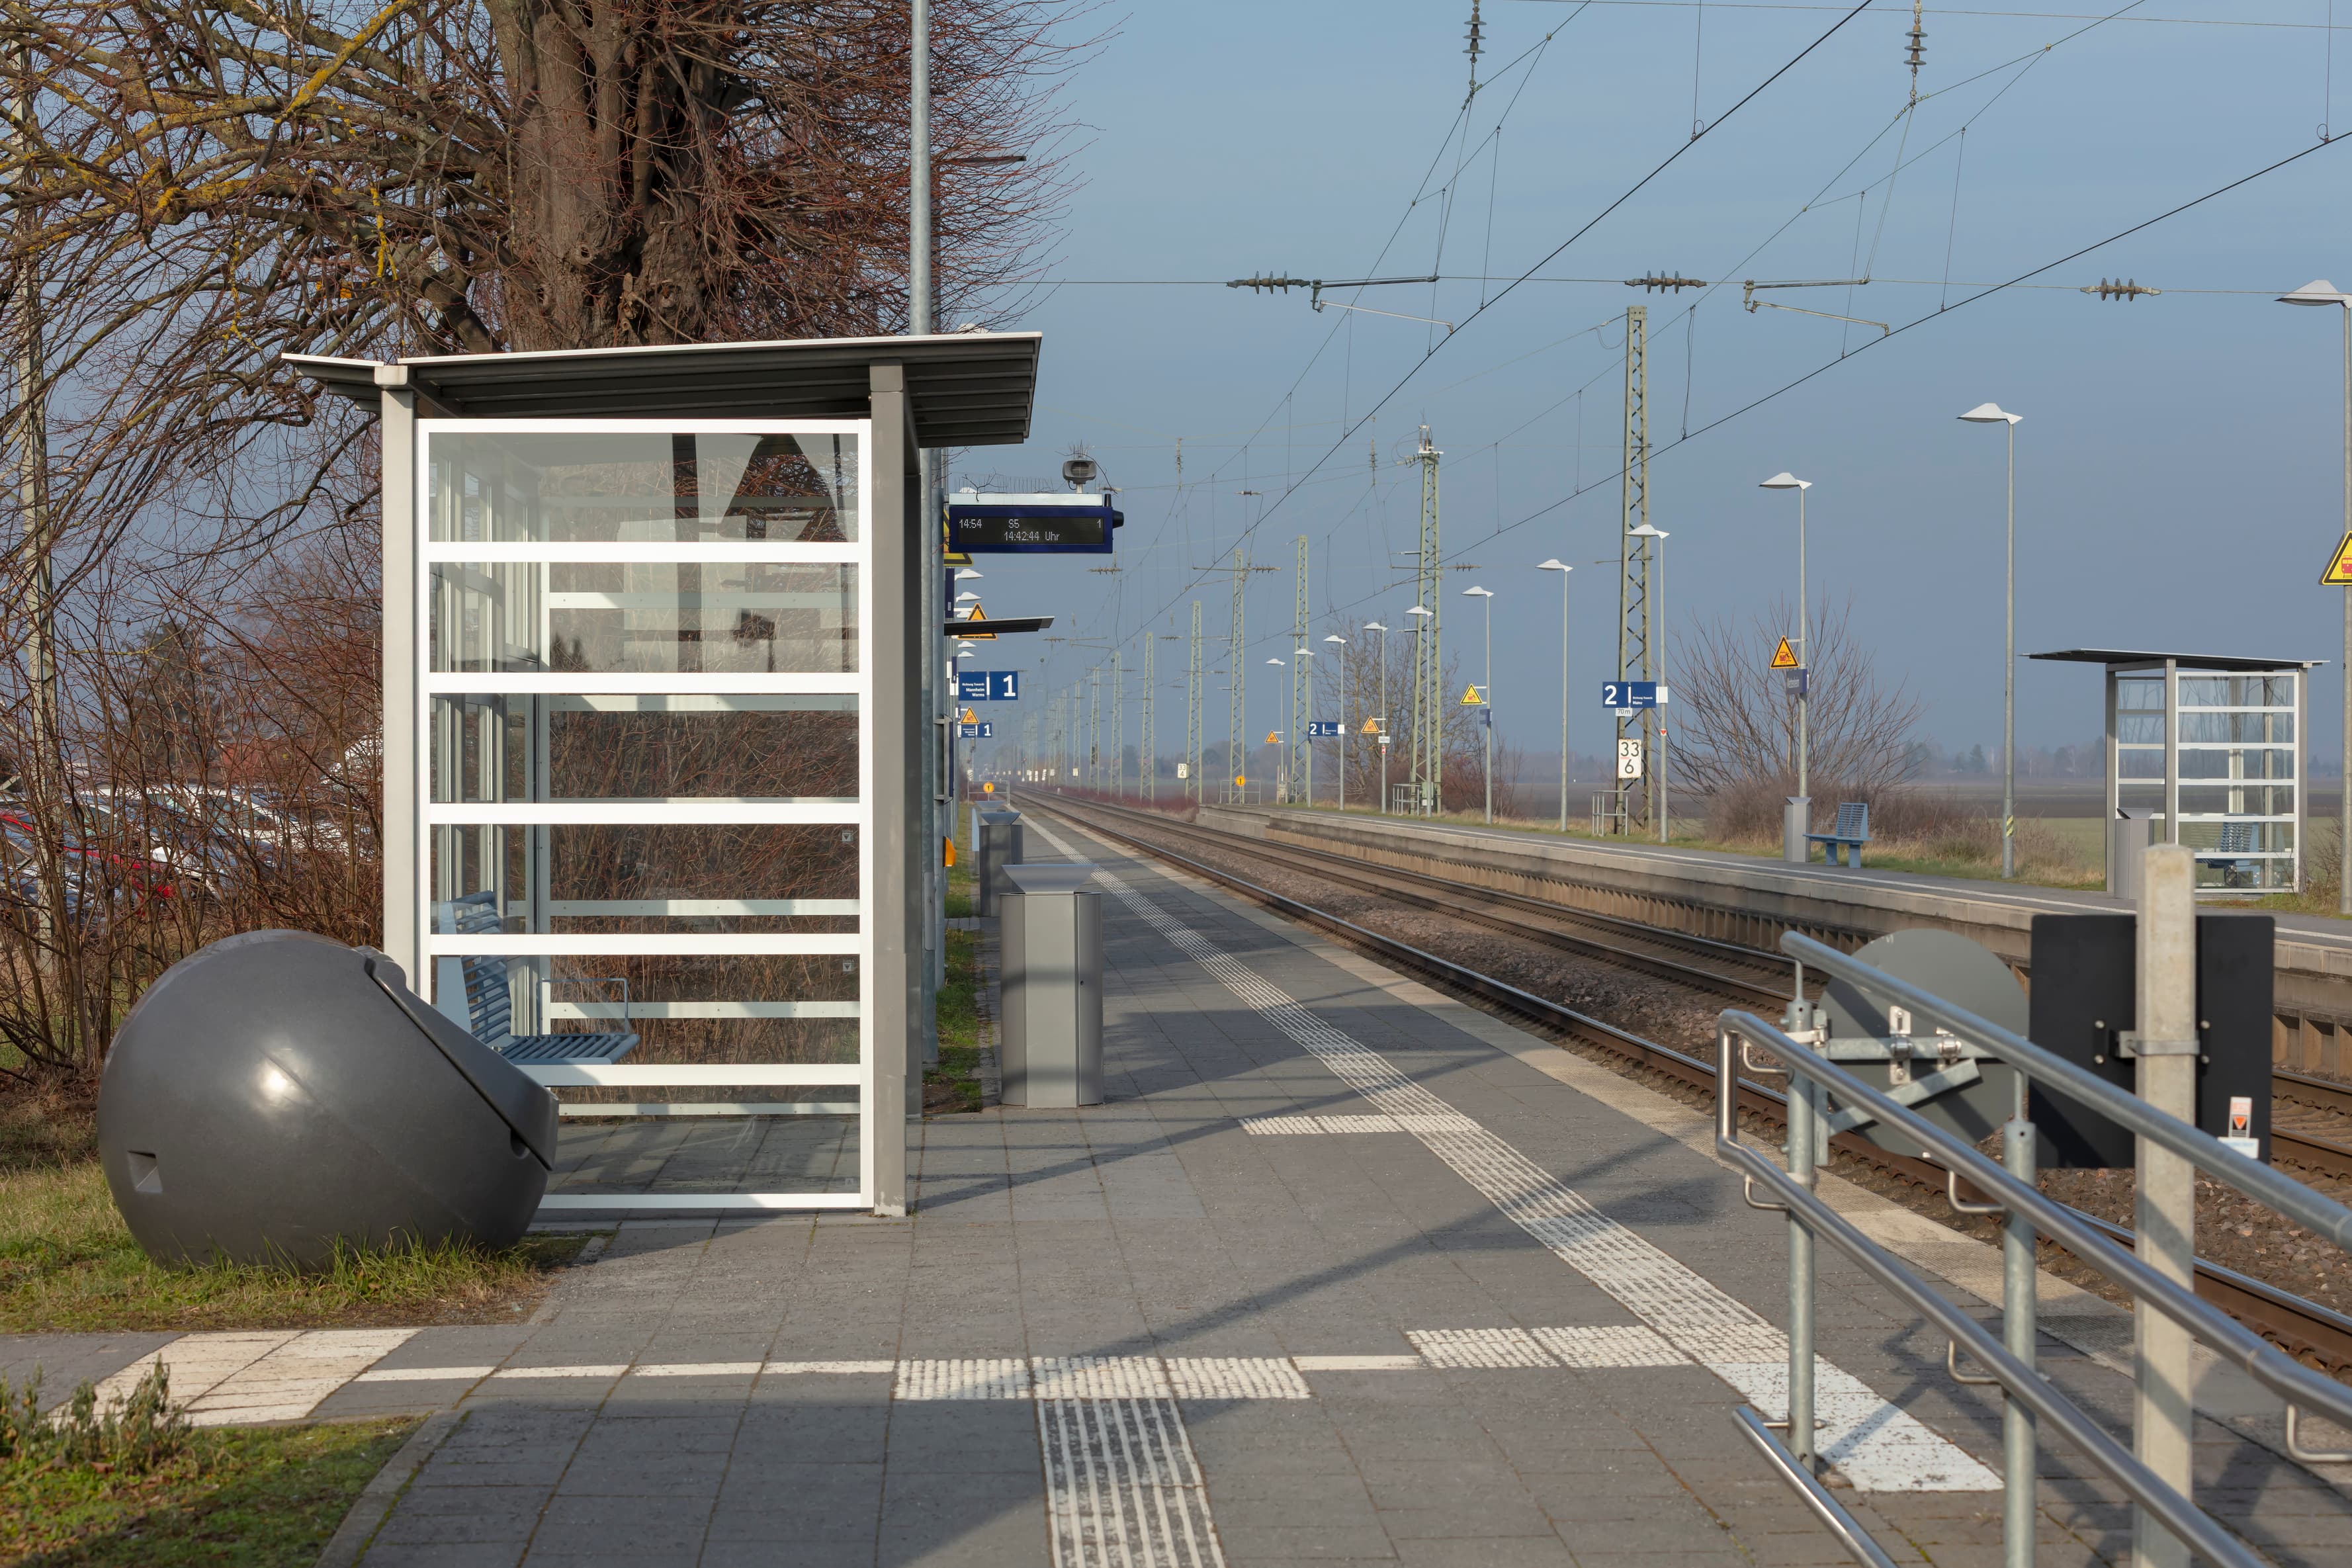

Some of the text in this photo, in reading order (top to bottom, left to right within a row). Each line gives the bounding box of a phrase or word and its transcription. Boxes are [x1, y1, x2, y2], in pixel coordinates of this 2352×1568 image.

[959, 519, 1101, 529] 14:54 S5 1
[1004, 531, 1060, 541] 14:42:44 Uhr
[1003, 675, 1016, 697] 1
[1604, 685, 1617, 705] 2
[984, 724, 991, 736] 1
[1310, 723, 1317, 734] 2
[1621, 742, 1639, 757] 33
[1625, 759, 1634, 773] 6
